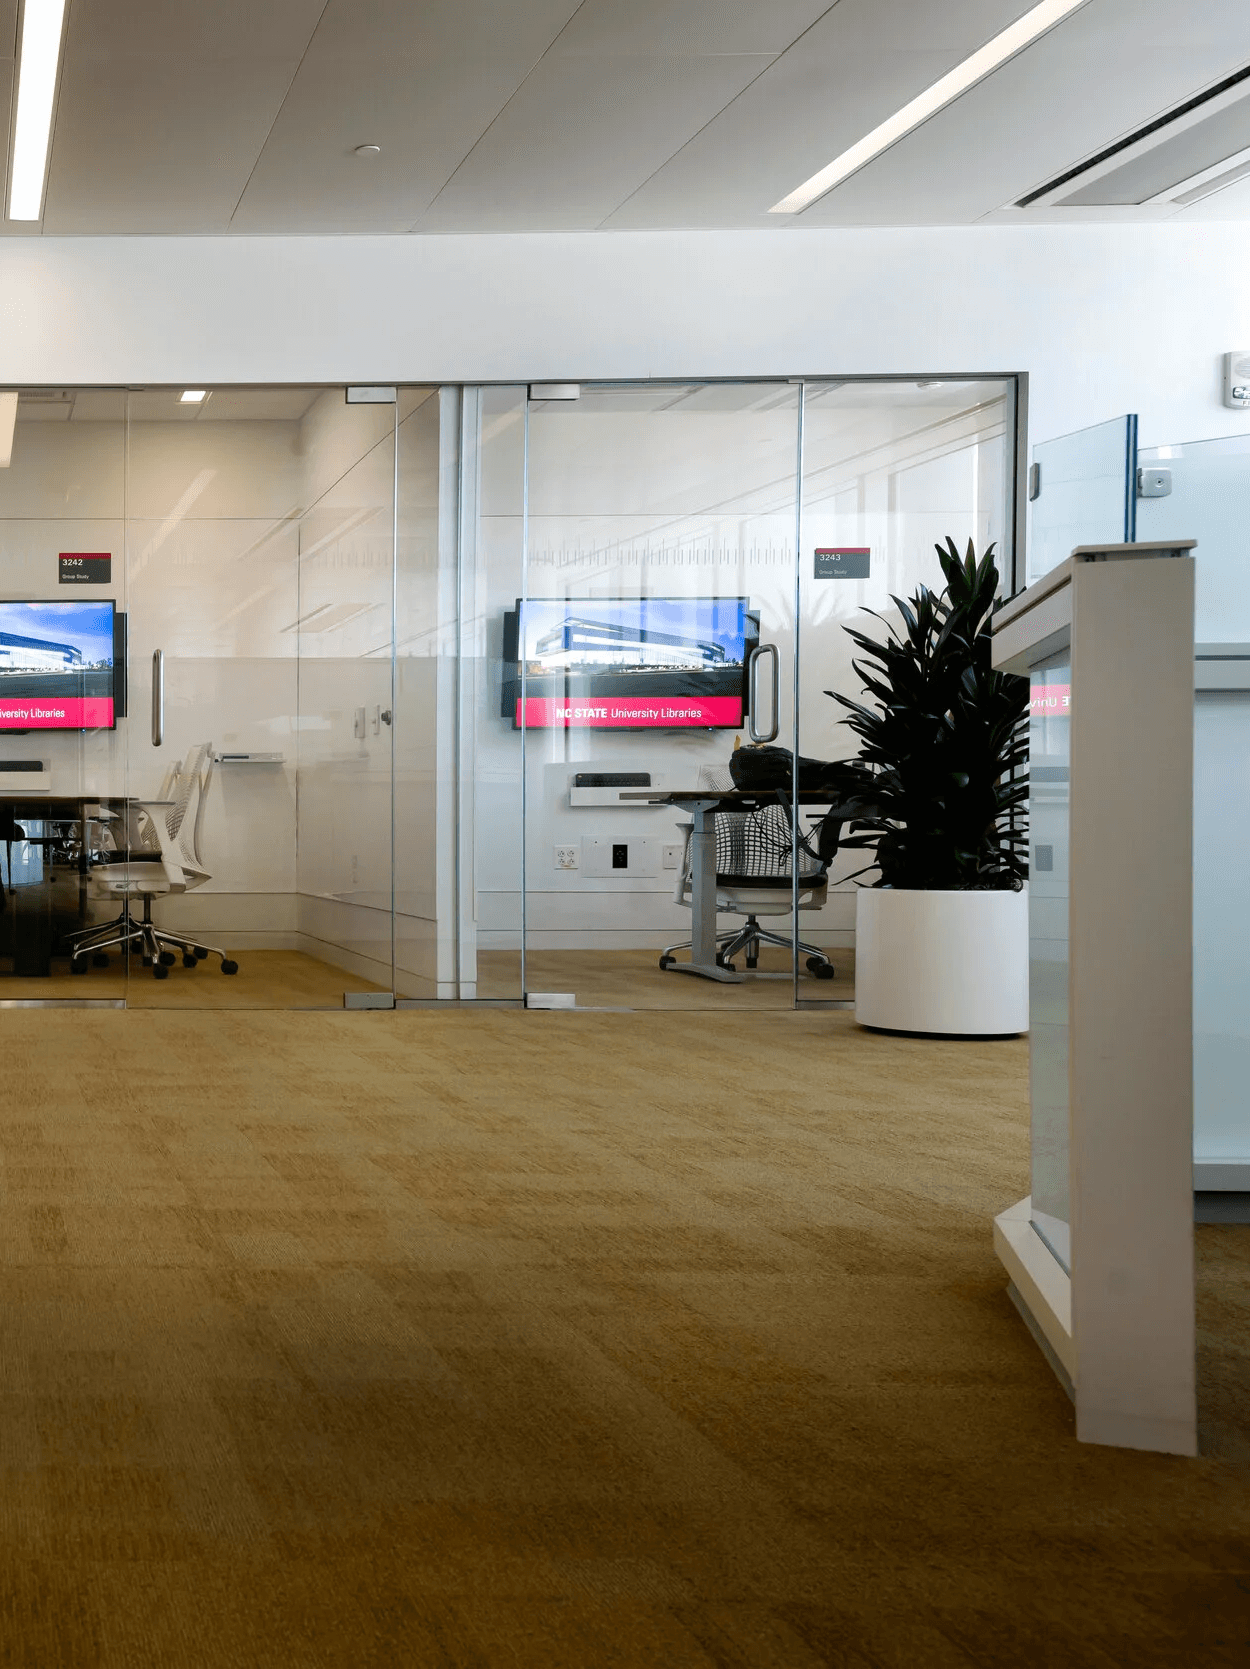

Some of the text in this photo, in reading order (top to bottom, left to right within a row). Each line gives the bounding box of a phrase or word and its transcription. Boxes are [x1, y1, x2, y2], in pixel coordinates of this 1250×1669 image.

[819, 553, 841, 561] 3243
[62, 558, 83, 566] 3242
[30, 708, 66, 718] Libraries
[555, 707, 702, 719] NC STATE University Libraries
